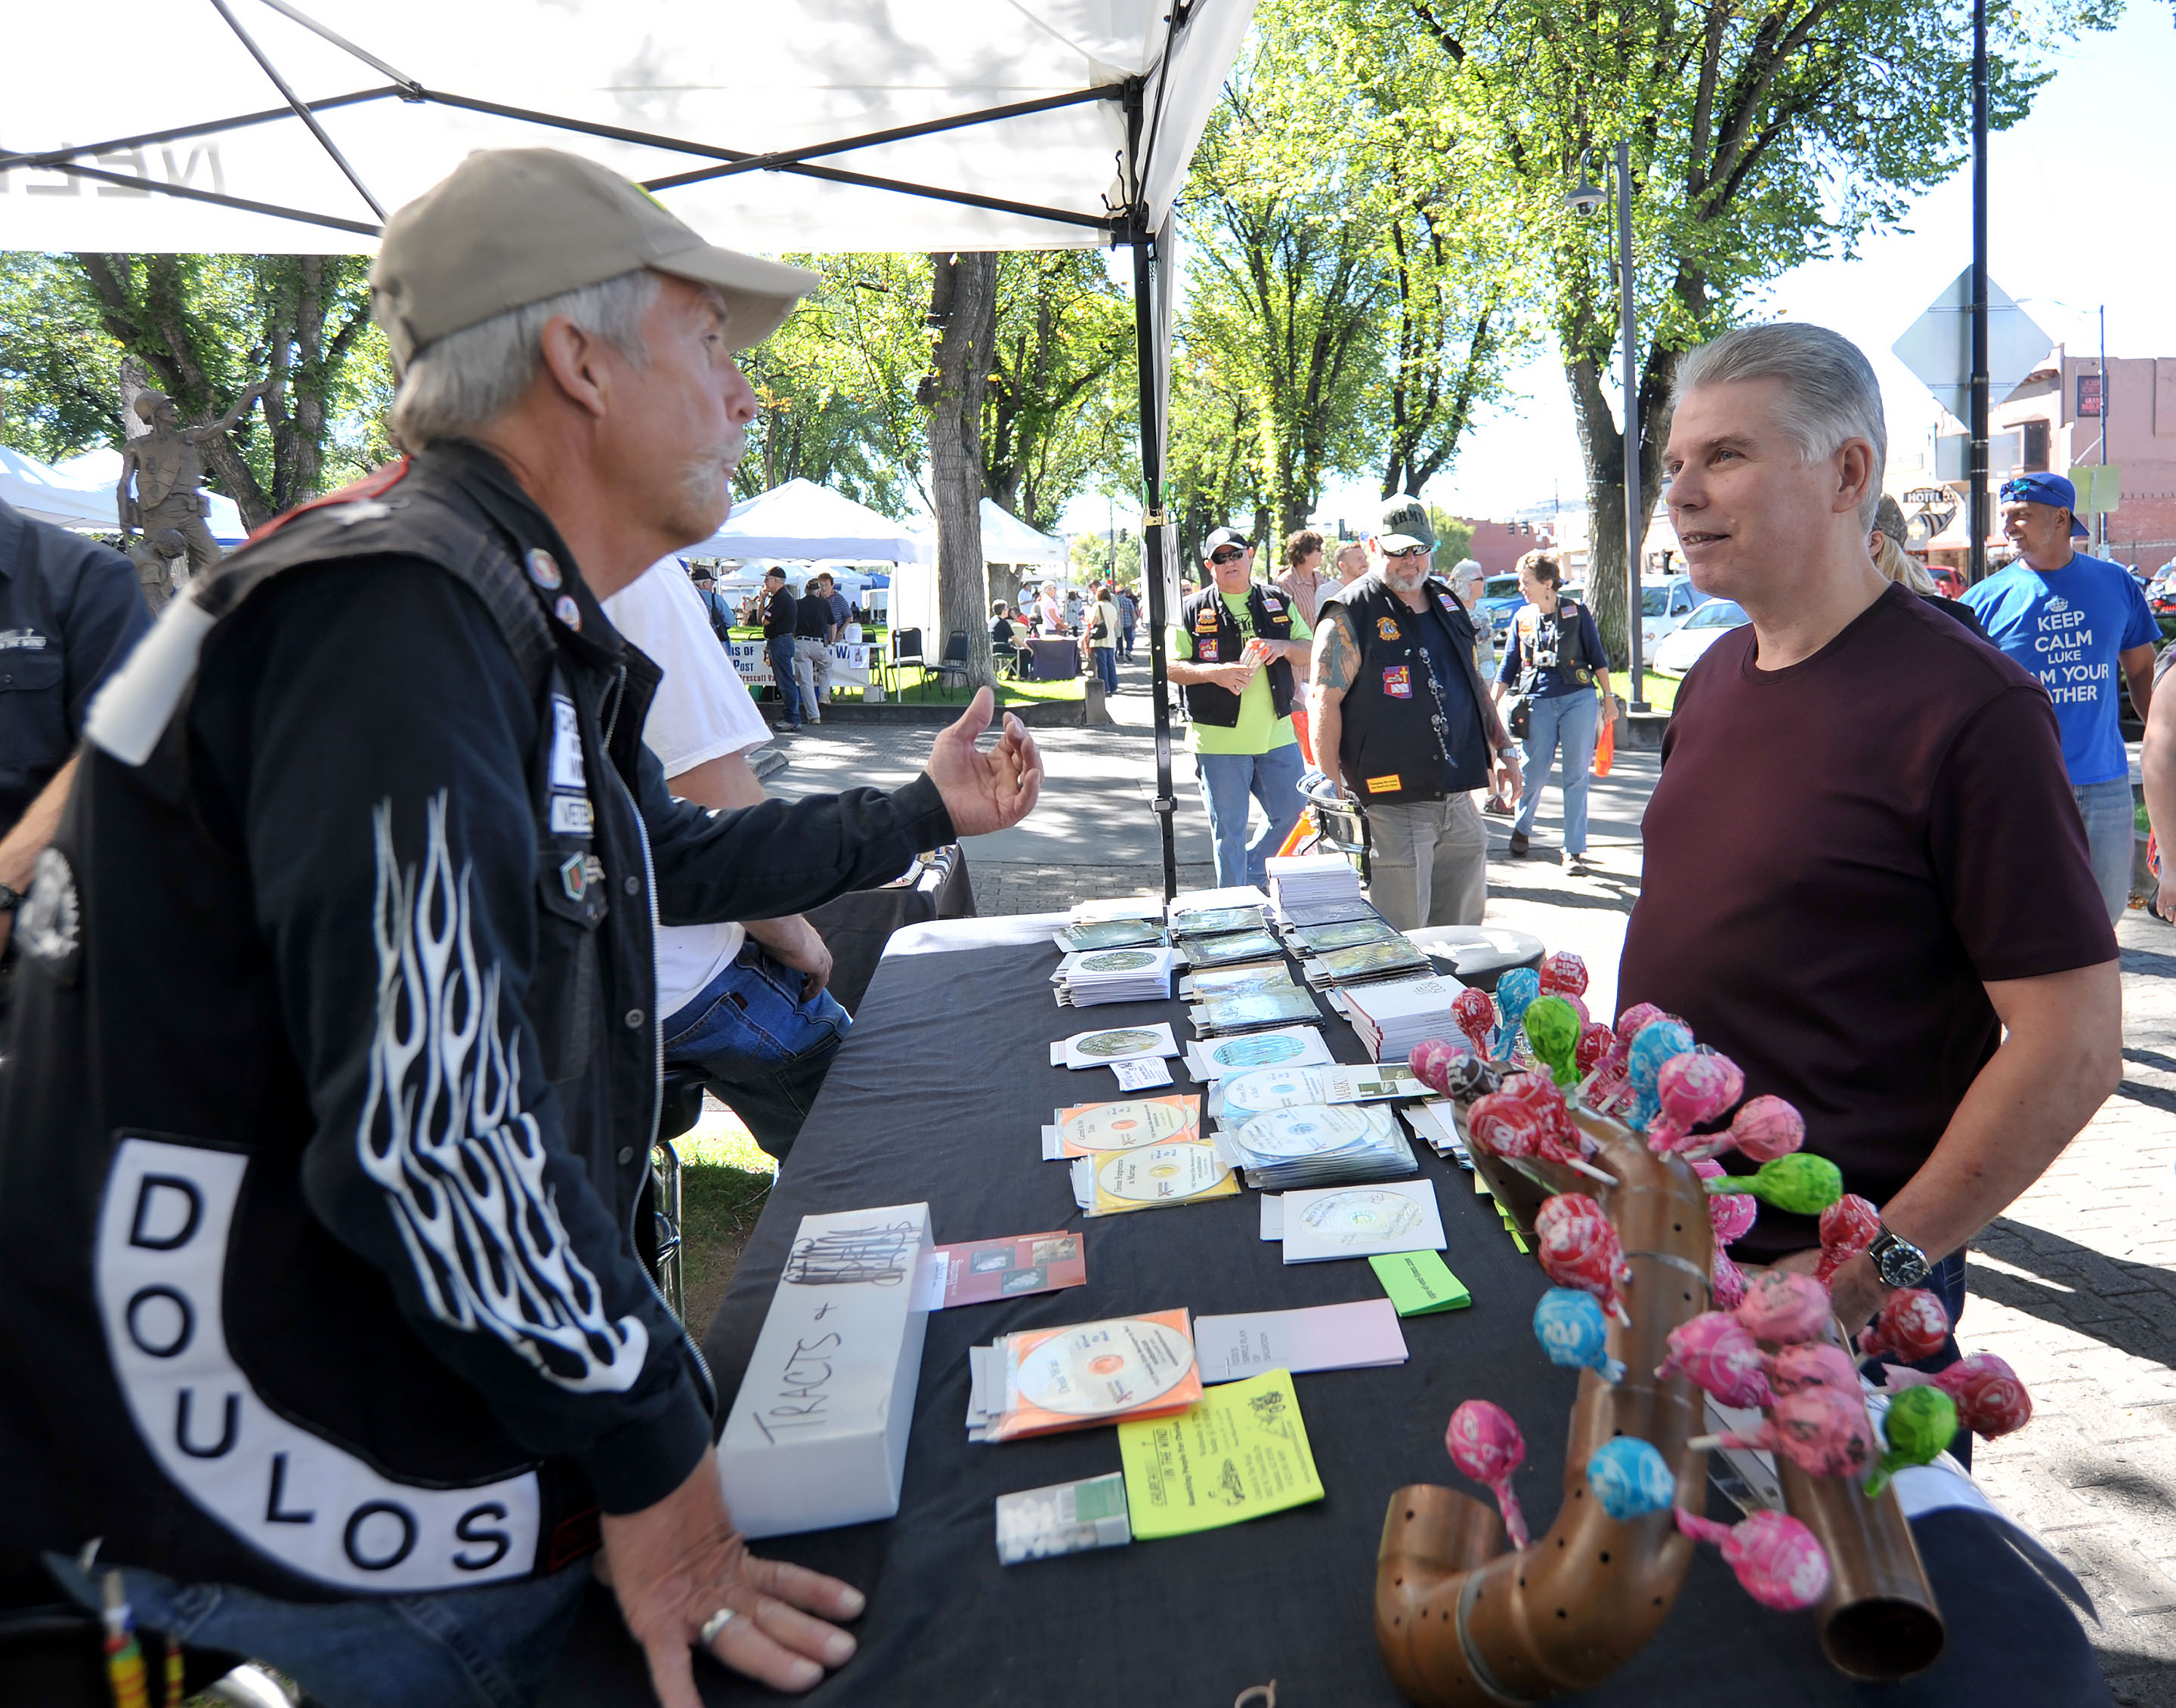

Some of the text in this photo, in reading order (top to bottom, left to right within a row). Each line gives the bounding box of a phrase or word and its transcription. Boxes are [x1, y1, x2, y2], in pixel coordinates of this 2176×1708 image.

[1907, 493, 1940, 502] HOTEL
[1391, 509, 1424, 530] ARMY
[2038, 610, 2085, 632] KEEP
[2035, 629, 2092, 653] CALM
[744, 647, 754, 656] OF
[2048, 650, 2082, 664] LUKE
[2062, 663, 2110, 680] YOUR
[2049, 685, 2097, 704] ATHER
[127, 1172, 512, 1573] DOULOS
[753, 1332, 842, 1444] TRACTS
